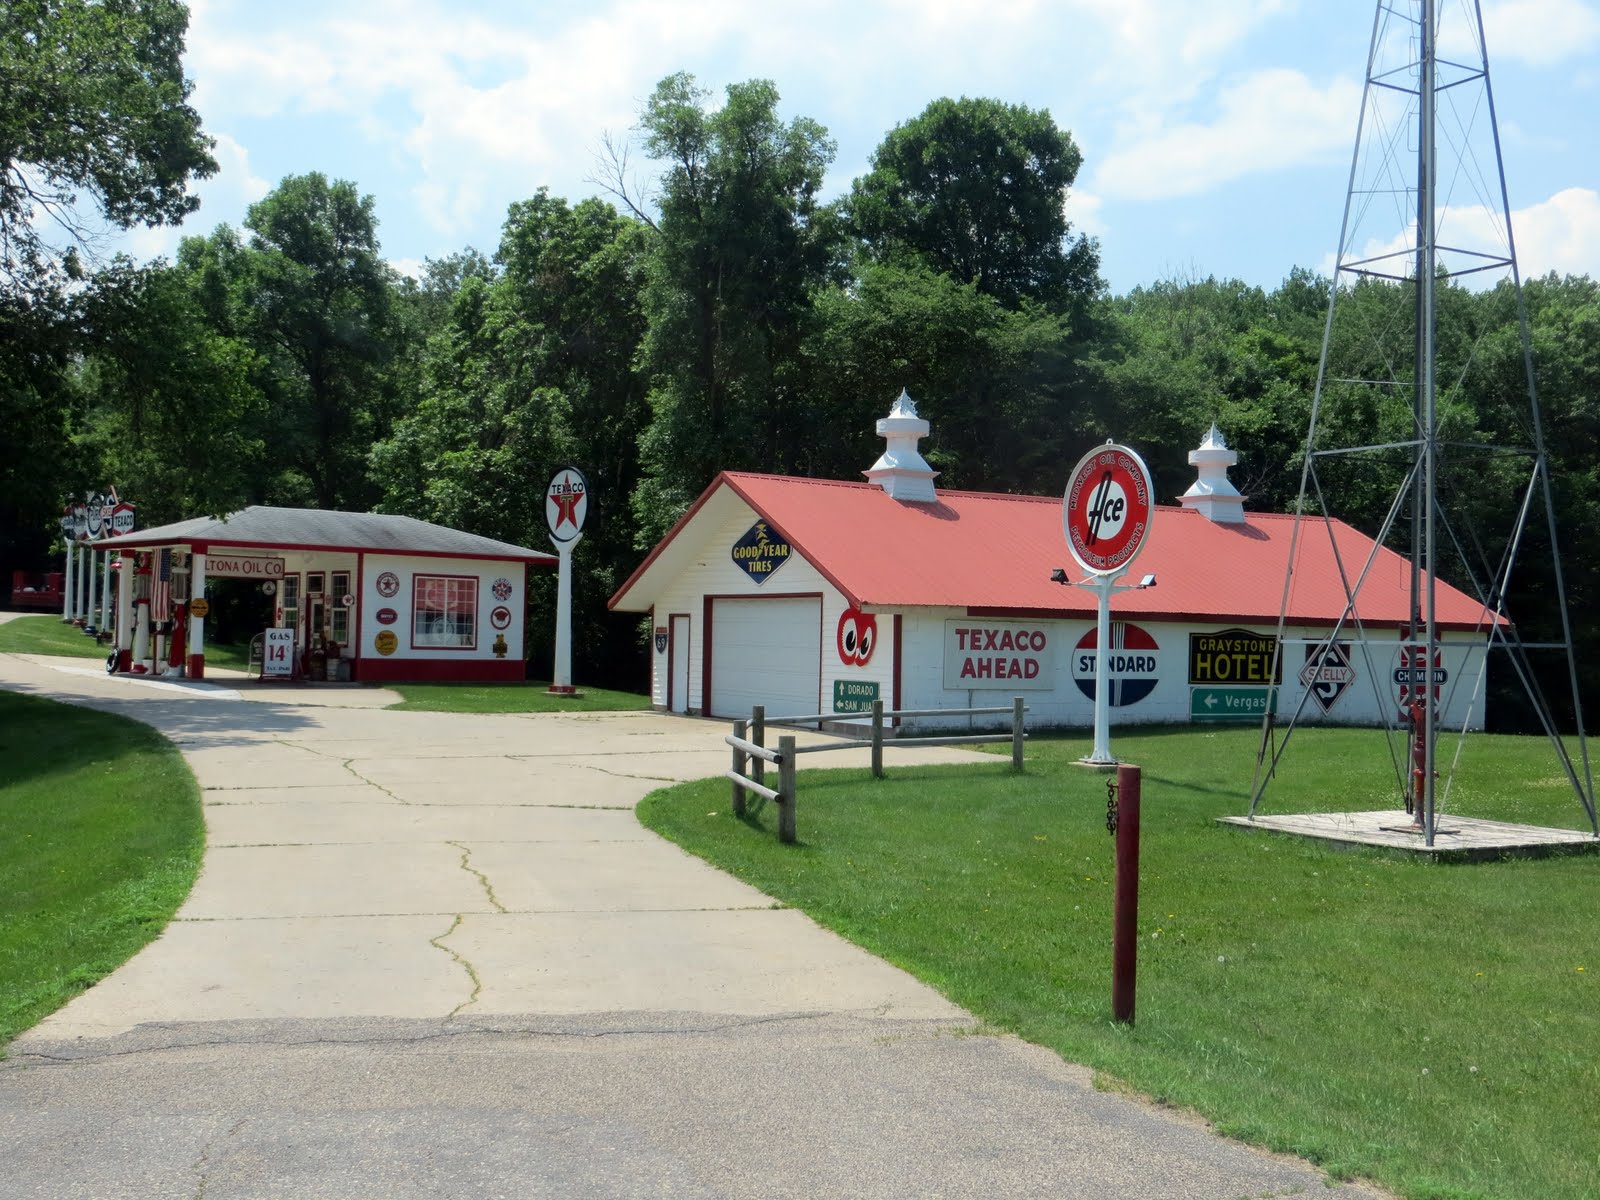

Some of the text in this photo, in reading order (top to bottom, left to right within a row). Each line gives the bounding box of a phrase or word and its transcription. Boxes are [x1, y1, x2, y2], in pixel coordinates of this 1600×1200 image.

[552, 482, 584, 494] TEXACO
[1070, 453, 1147, 510] MIDWEST OIL COMPANY
[114, 514, 133, 527] TEXACO
[1071, 522, 1144, 567] PETROLEUM PRODUCTS
[205, 559, 239, 573] LTONA
[242, 560, 262, 574] OIL
[748, 561, 772, 573] TIRES
[270, 632, 290, 640] GAS
[955, 628, 1047, 652] TEXACO
[656, 637, 666, 649] 69
[1199, 639, 1275, 652] GRAYSTONE
[960, 657, 1040, 680] AHEAD
[1079, 655, 1157, 673] STNDARD
[1196, 653, 1277, 680] HOTEL
[1397, 671, 1443, 681] CHMIN
[847, 684, 874, 696] DORADO
[844, 700, 874, 712] SAN JUA
[1225, 695, 1266, 711] Vergas
